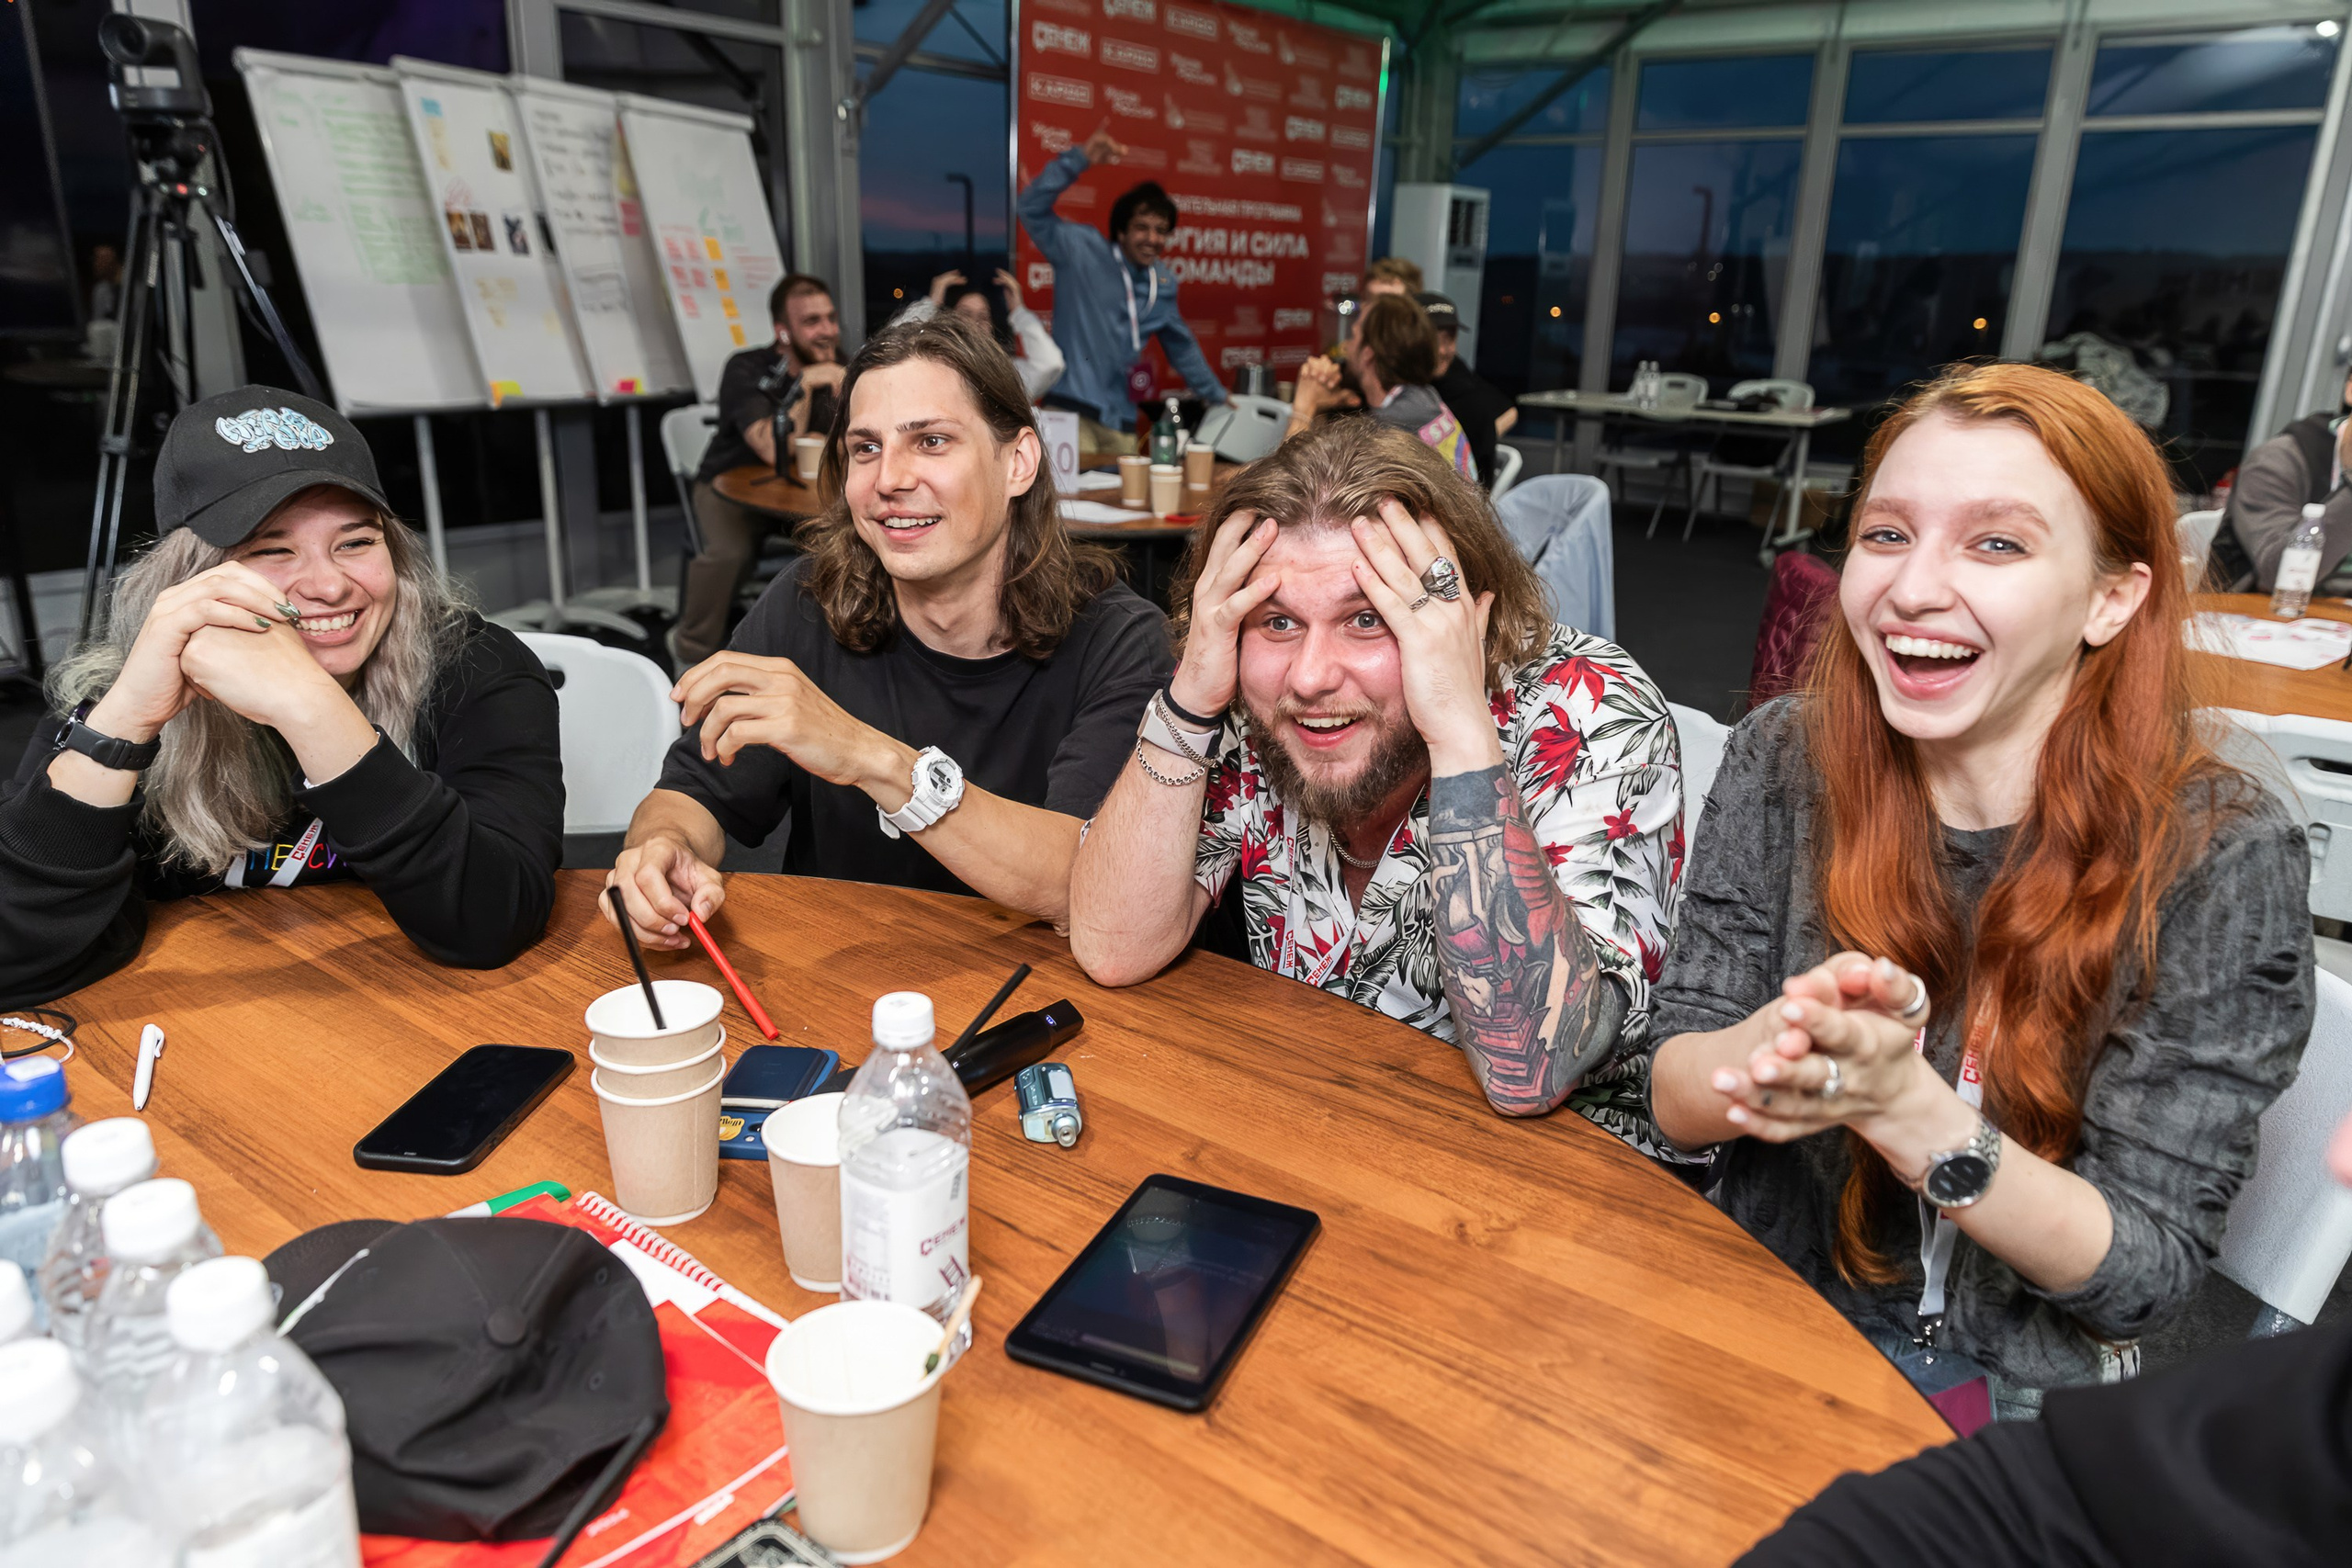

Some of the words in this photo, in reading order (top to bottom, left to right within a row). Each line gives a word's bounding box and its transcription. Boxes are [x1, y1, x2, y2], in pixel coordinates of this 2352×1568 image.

[1230, 229, 1249, 255] И
[1250, 231, 1308, 258] СИЛА
[1285, 929, 1295, 969] СЕНЕЖ
[1306, 953, 1333, 987] СЕНЕЖ
